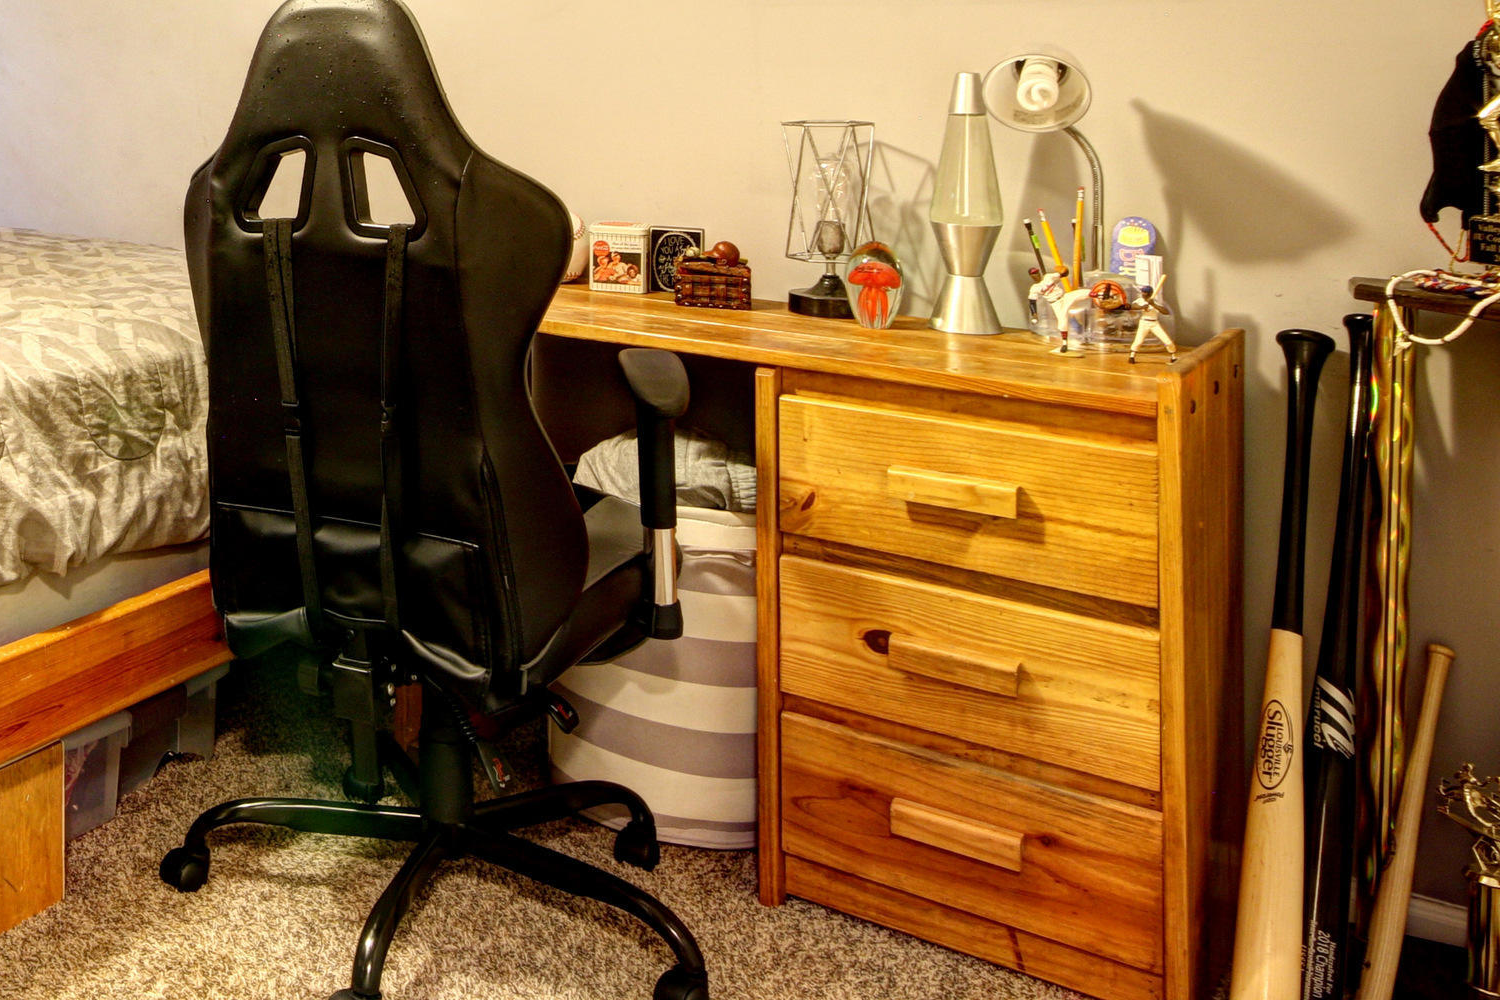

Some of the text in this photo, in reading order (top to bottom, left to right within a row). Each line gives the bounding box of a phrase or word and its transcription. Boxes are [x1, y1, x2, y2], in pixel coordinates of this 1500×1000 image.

[1260, 708, 1284, 779] Slugger
[1272, 727, 1285, 778] LOUISVILLE
[1312, 929, 1331, 999] 2018 Champion
